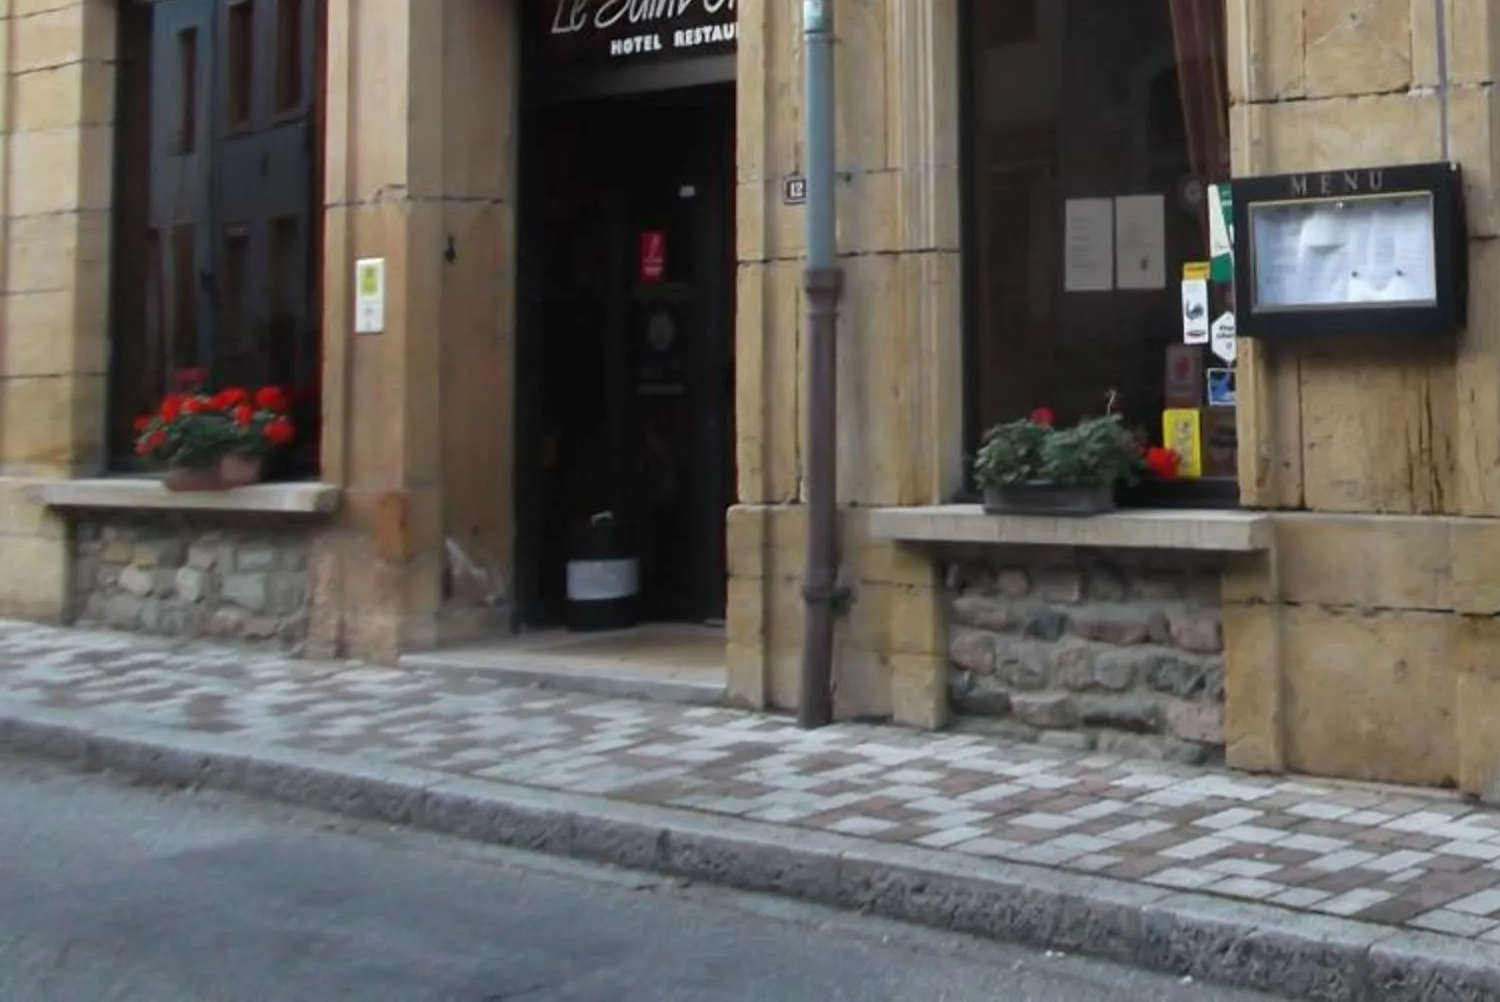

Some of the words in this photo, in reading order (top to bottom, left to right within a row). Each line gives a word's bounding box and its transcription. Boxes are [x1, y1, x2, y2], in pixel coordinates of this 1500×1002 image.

[610, 32, 662, 56] HOTEL
[673, 21, 739, 47] RESTAU
[1290, 169, 1384, 197] MENU
